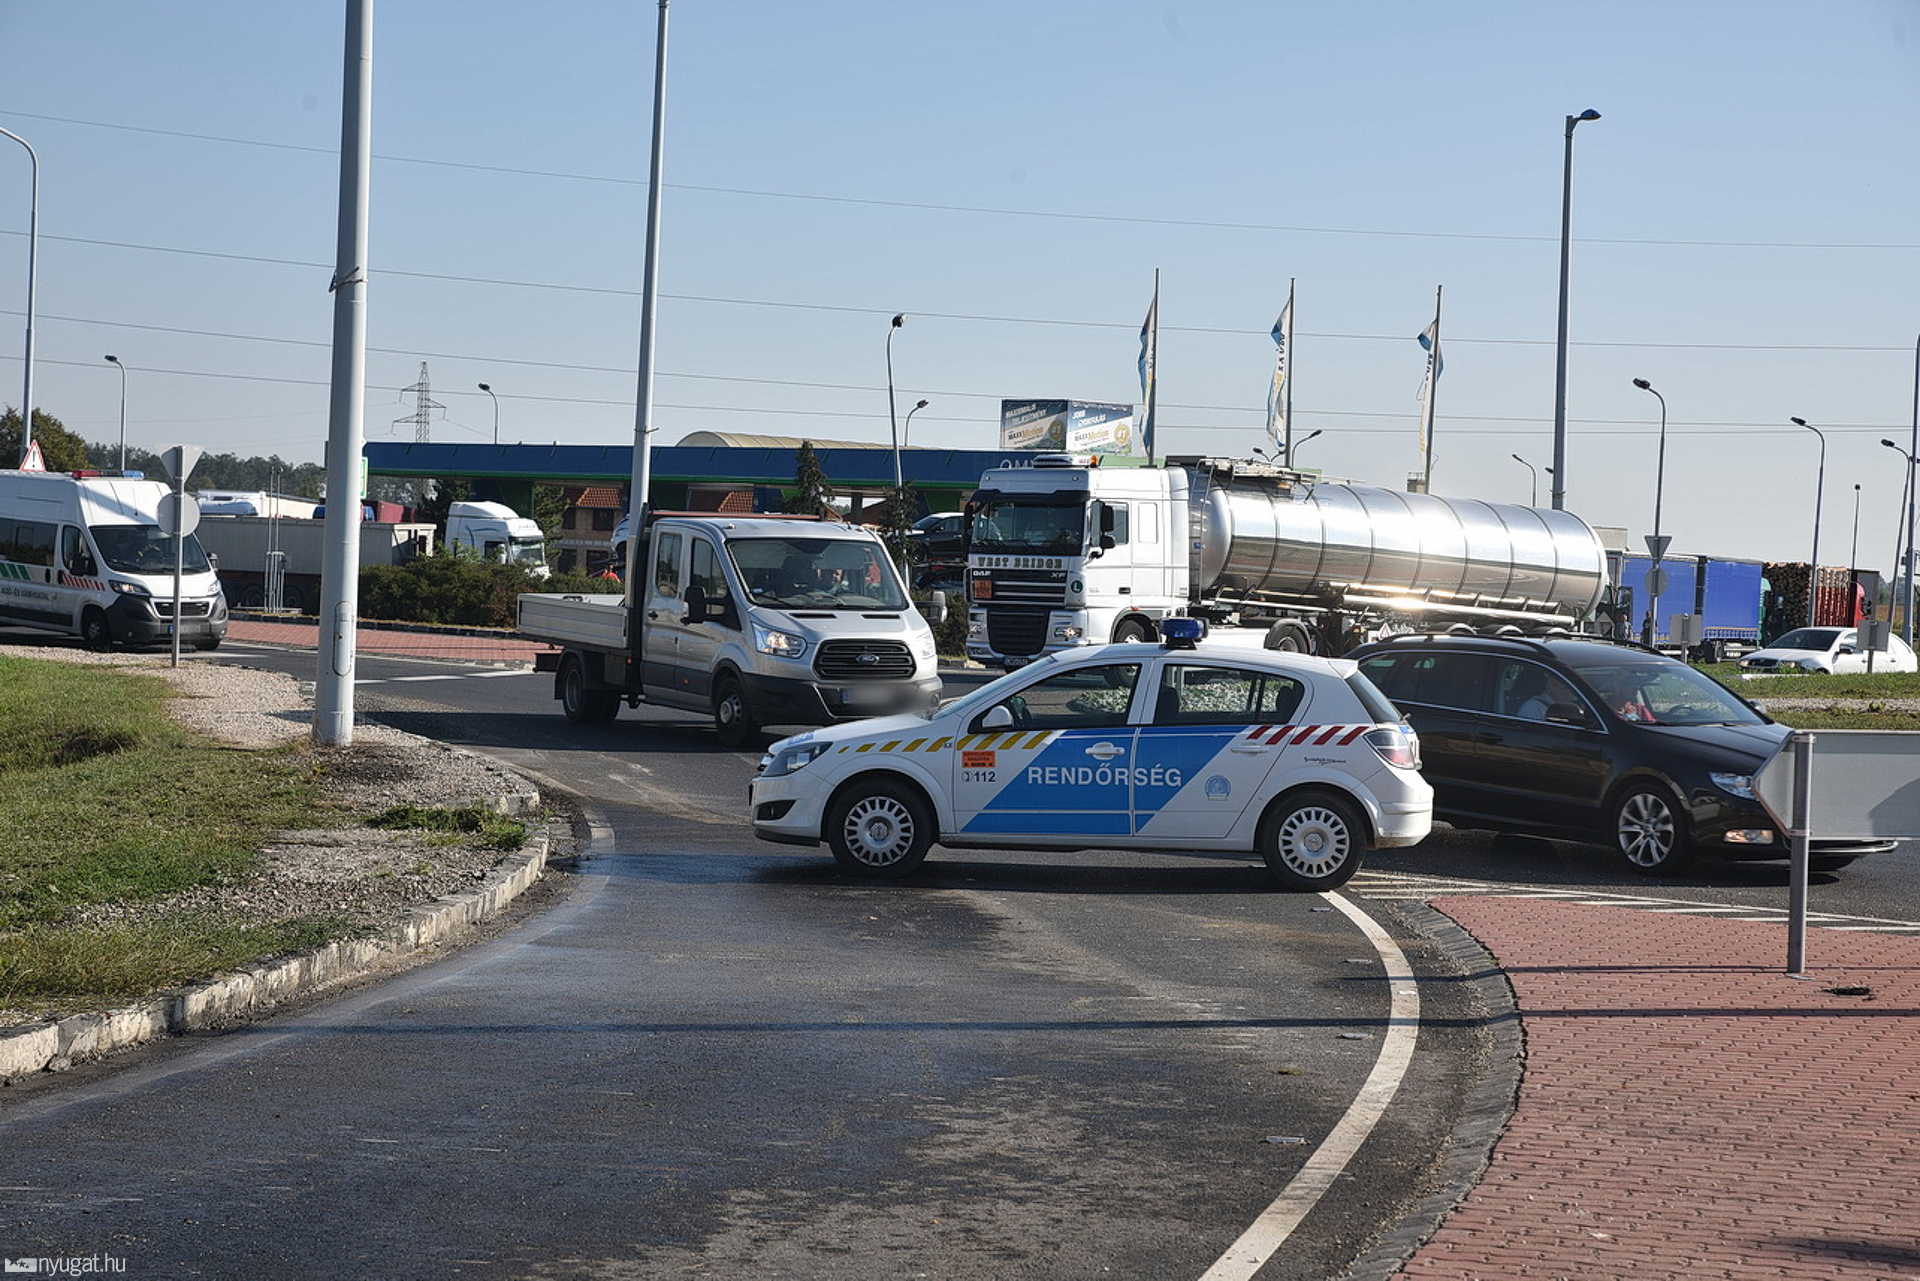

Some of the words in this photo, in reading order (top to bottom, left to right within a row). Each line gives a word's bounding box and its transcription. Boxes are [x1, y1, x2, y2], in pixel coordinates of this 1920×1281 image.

[1000, 459, 1033, 470] OM
[974, 771, 996, 783] 112
[1028, 763, 1182, 787] RENDŐRSÉG
